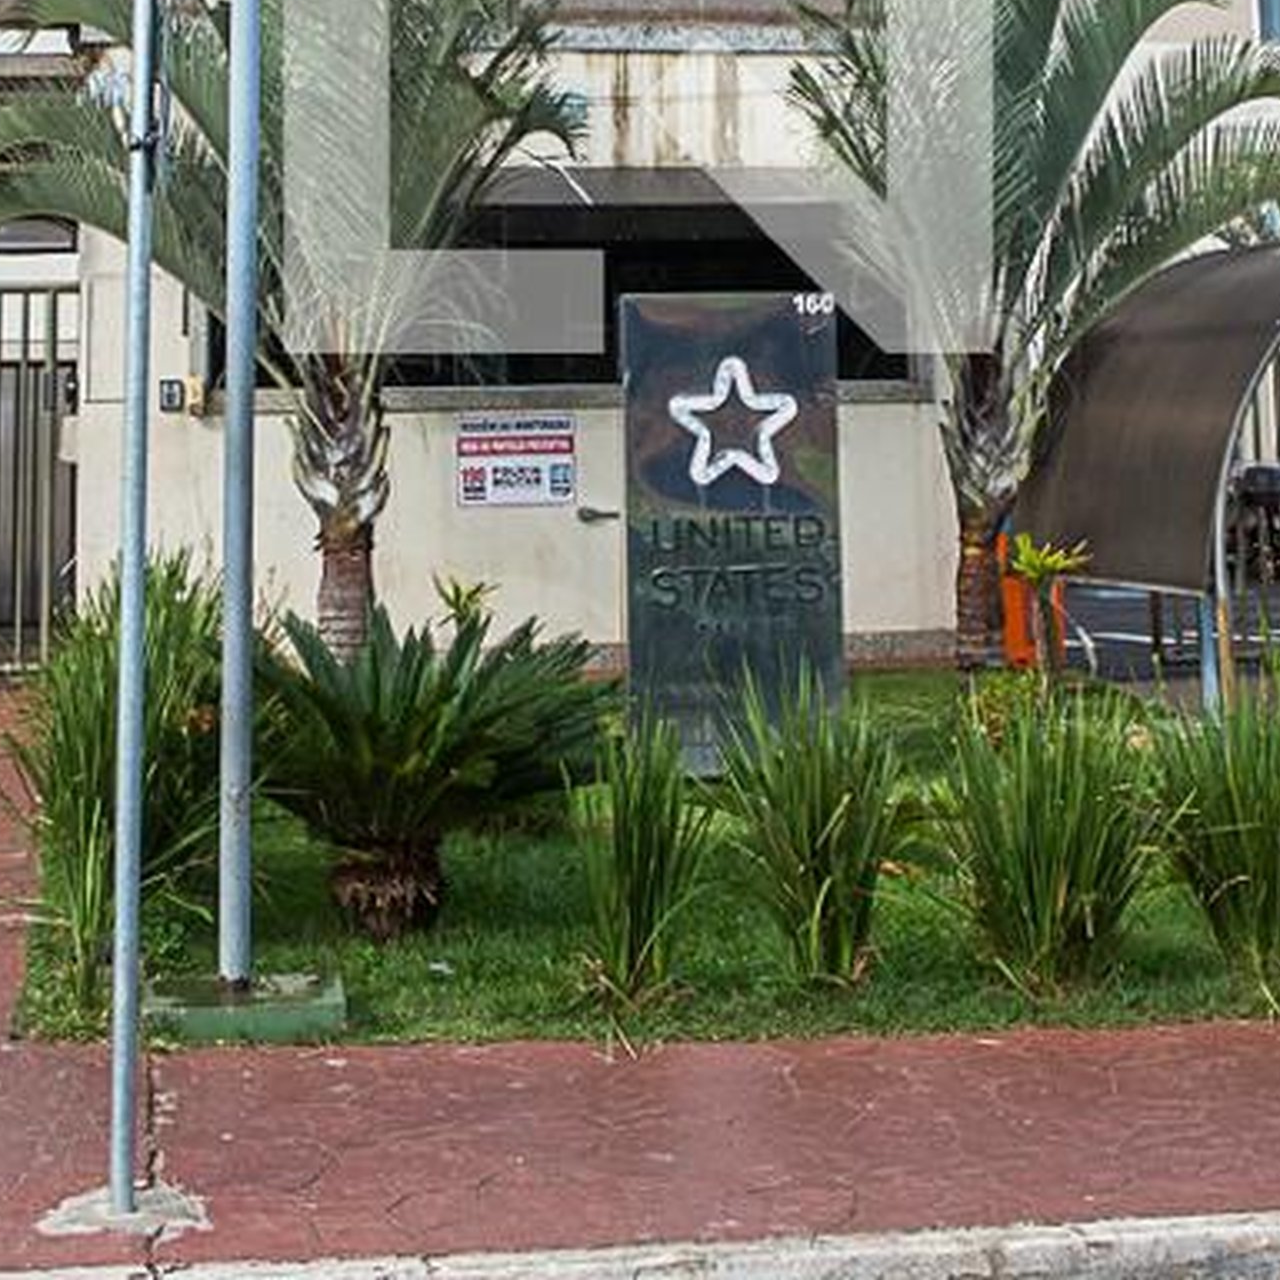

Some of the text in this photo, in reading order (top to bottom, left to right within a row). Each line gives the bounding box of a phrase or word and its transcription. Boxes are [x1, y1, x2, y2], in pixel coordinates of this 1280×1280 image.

[793, 292, 835, 315] 160
[651, 516, 825, 549] UNITED
[651, 566, 825, 608] STATES
